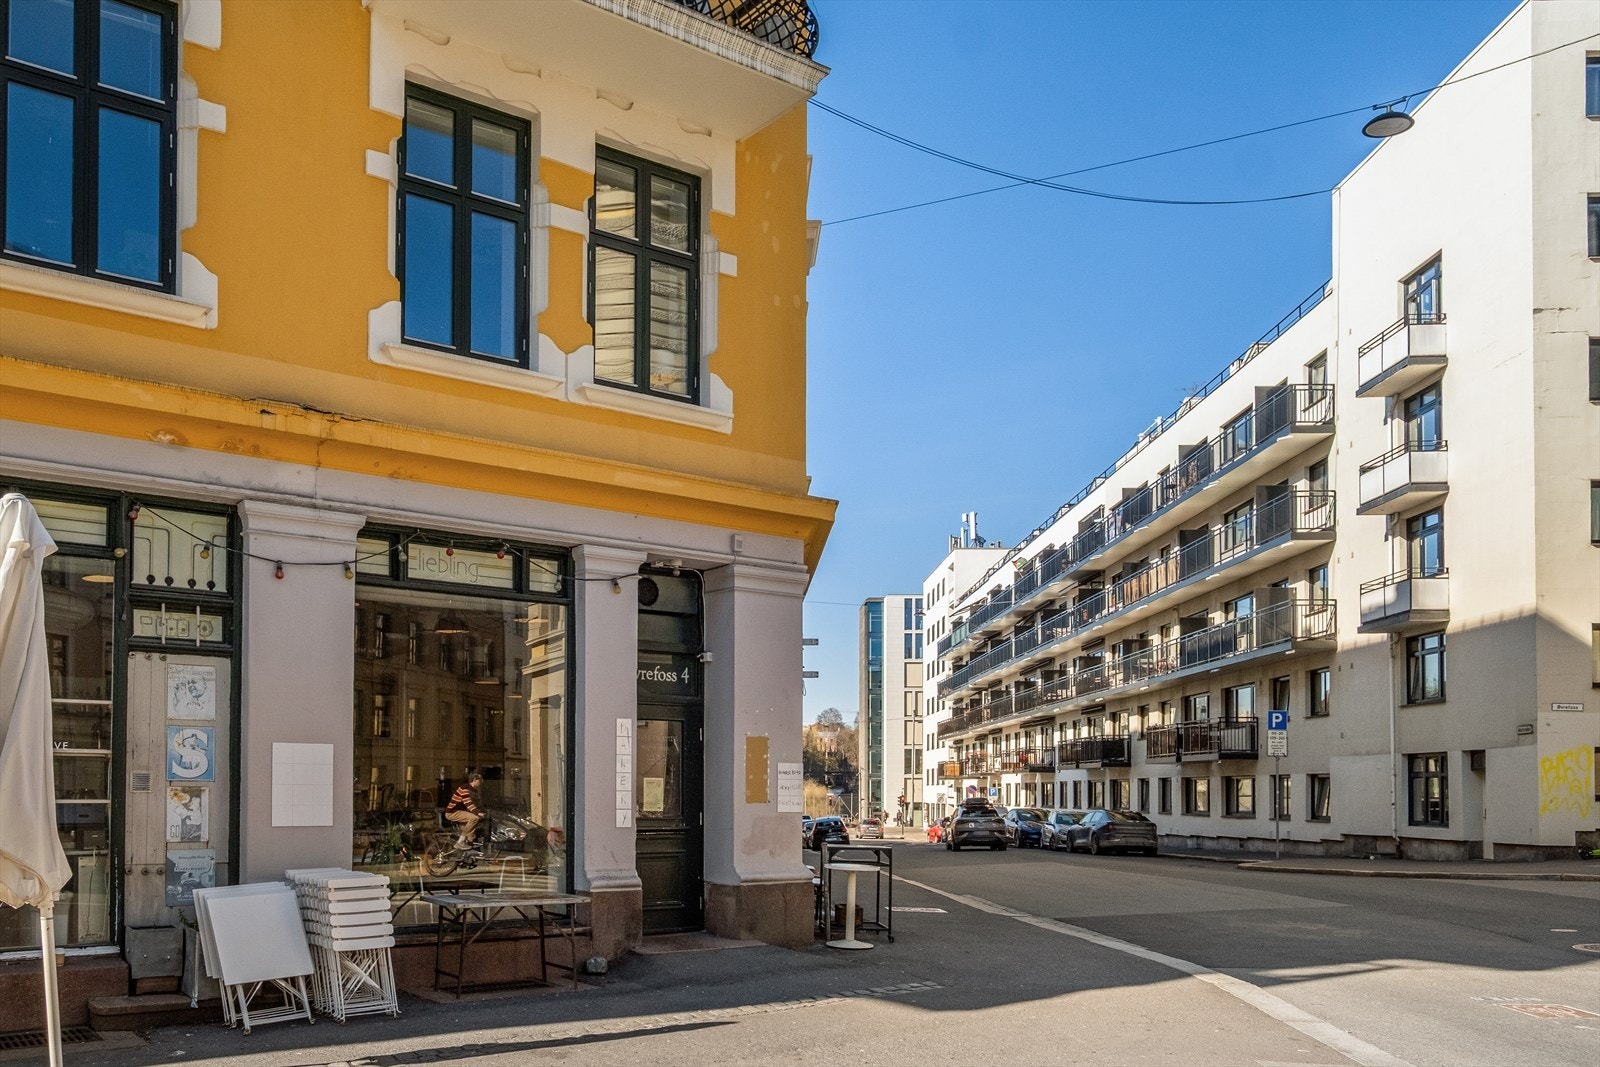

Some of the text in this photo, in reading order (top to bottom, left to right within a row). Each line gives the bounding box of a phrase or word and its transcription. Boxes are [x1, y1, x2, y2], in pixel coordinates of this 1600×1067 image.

[418, 548, 479, 583] liebling
[681, 667, 690, 684] 4
[1272, 713, 1283, 728] P
[53, 741, 69, 750] VE
